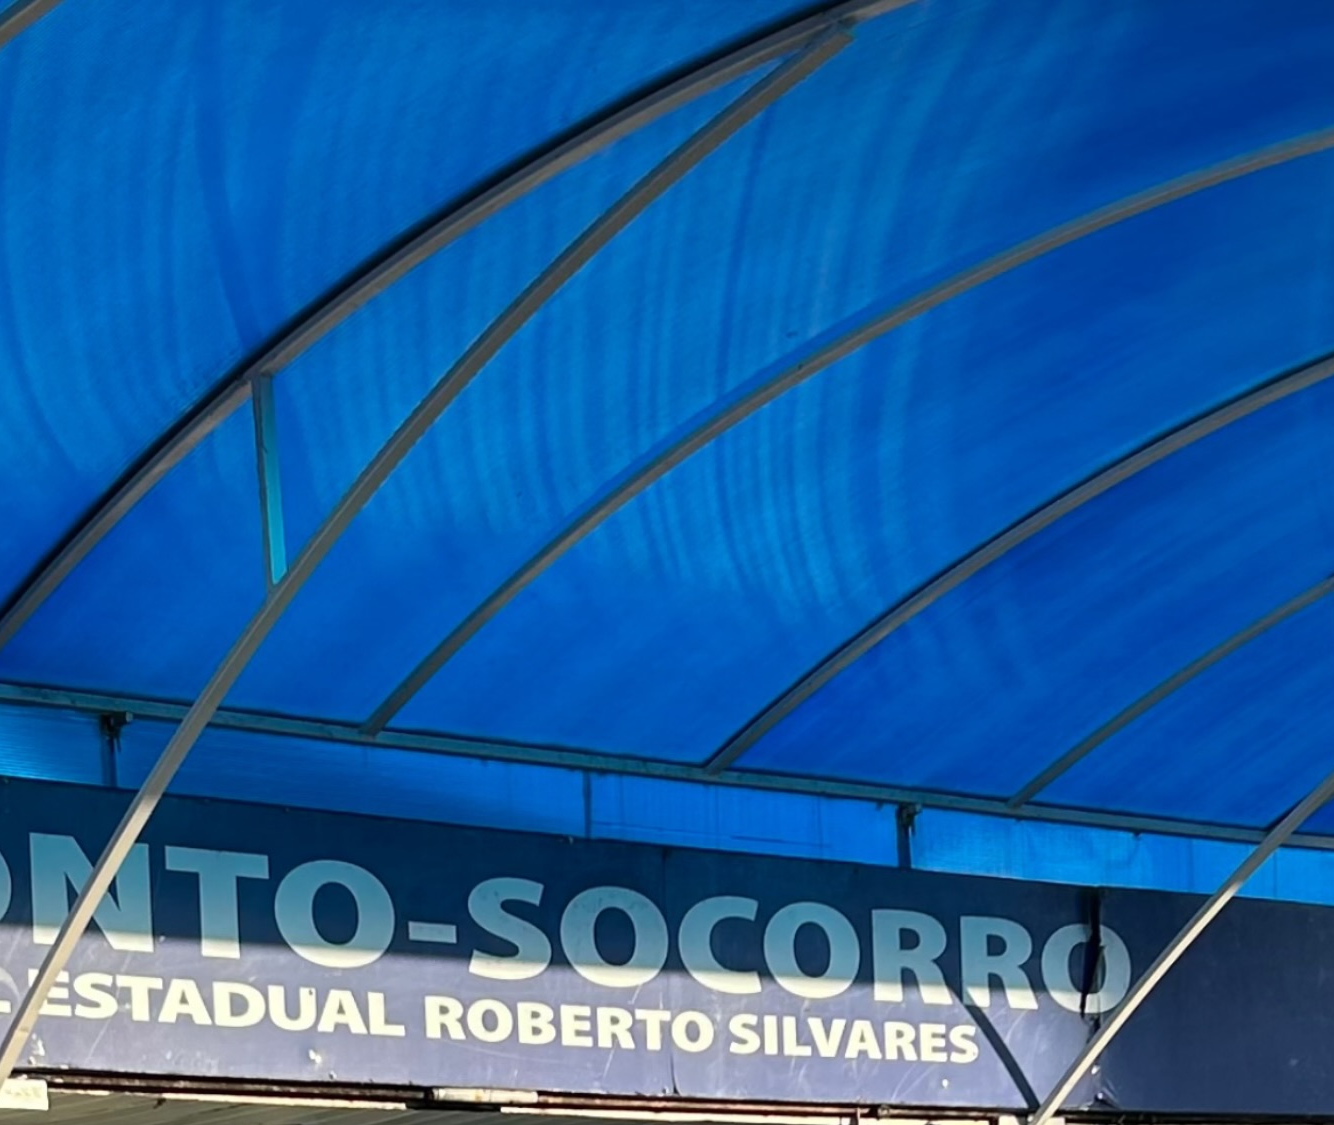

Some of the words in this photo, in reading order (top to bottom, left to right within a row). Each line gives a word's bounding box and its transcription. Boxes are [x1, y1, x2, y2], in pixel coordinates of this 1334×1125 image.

[28, 968, 405, 1036] ESTADUAL
[424, 995, 712, 1053] ROBERTO
[729, 1012, 979, 1064] SILVARES
